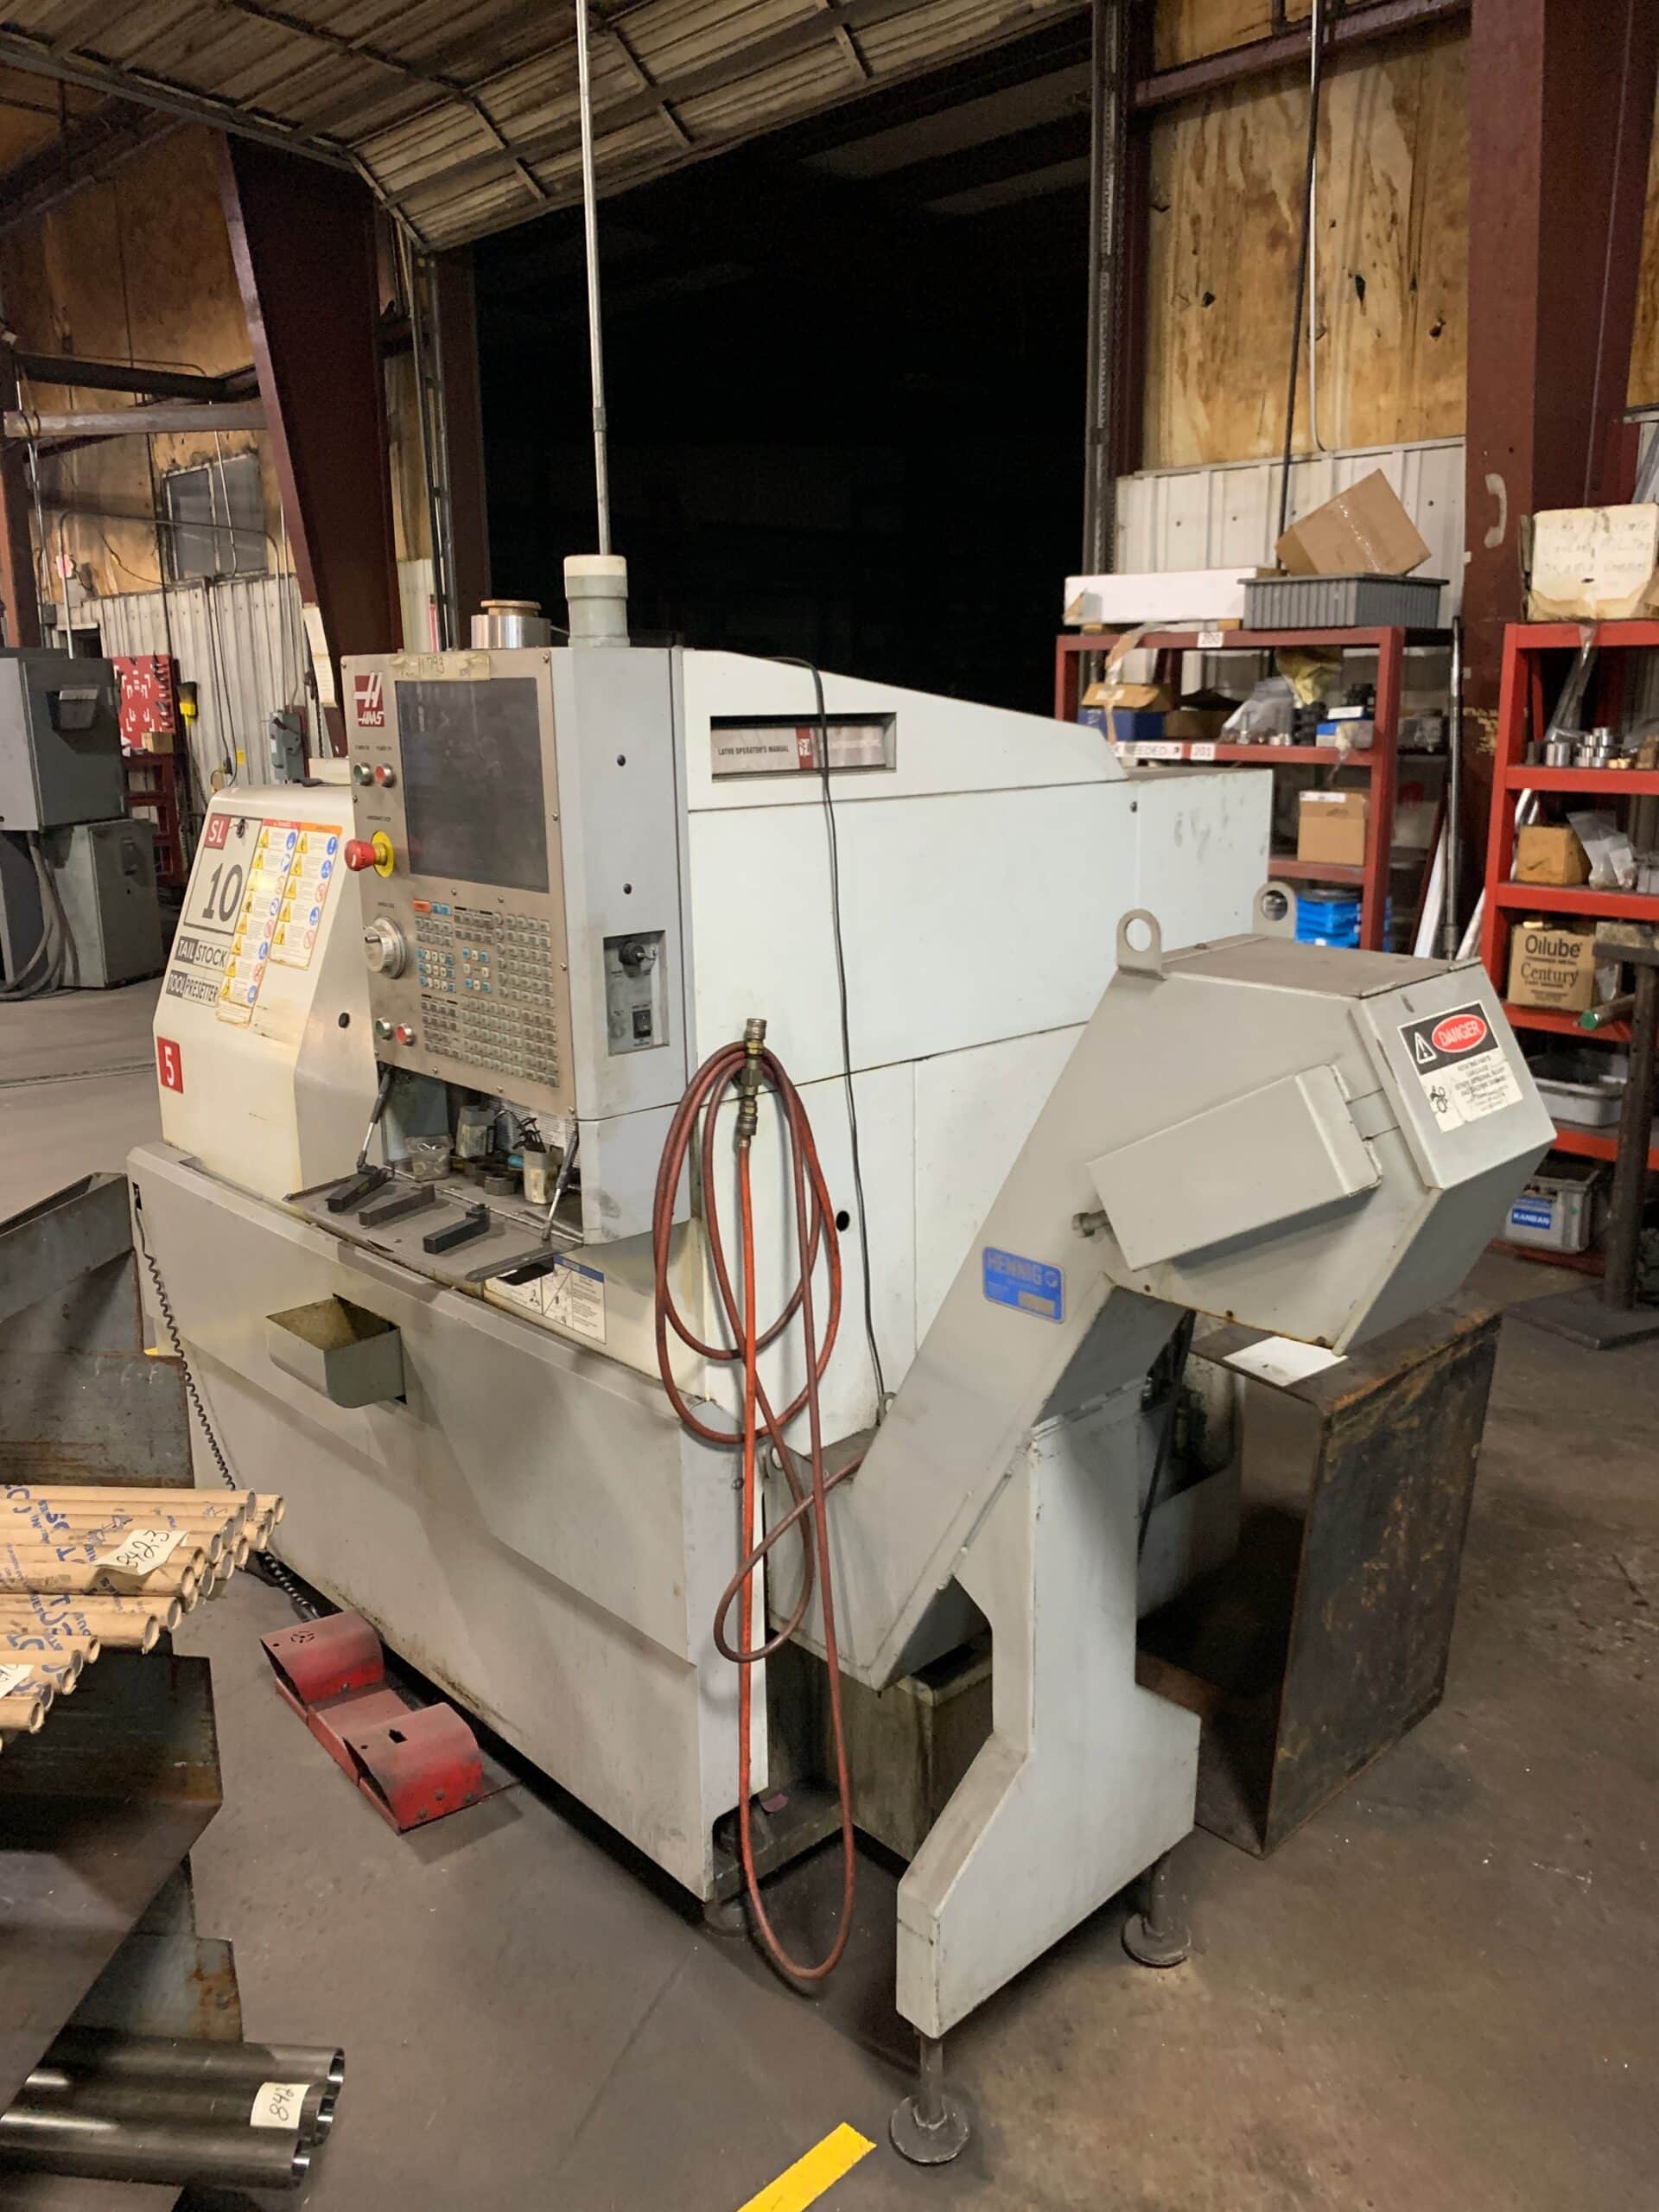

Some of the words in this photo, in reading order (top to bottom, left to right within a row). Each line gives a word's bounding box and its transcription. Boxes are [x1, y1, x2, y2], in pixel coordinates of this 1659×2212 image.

[358, 711, 385, 725] HAAS
[208, 820, 225, 844] SL
[202, 863, 243, 922] 10
[177, 939, 196, 960] TAIL
[195, 944, 228, 968] STOCK
[1525, 935, 1580, 958] Oilube
[1521, 962, 1580, 988] Century
[1438, 1020, 1481, 1047] DANGER
[164, 1046, 175, 1086] 5
[270, 2087, 295, 2121] 842
